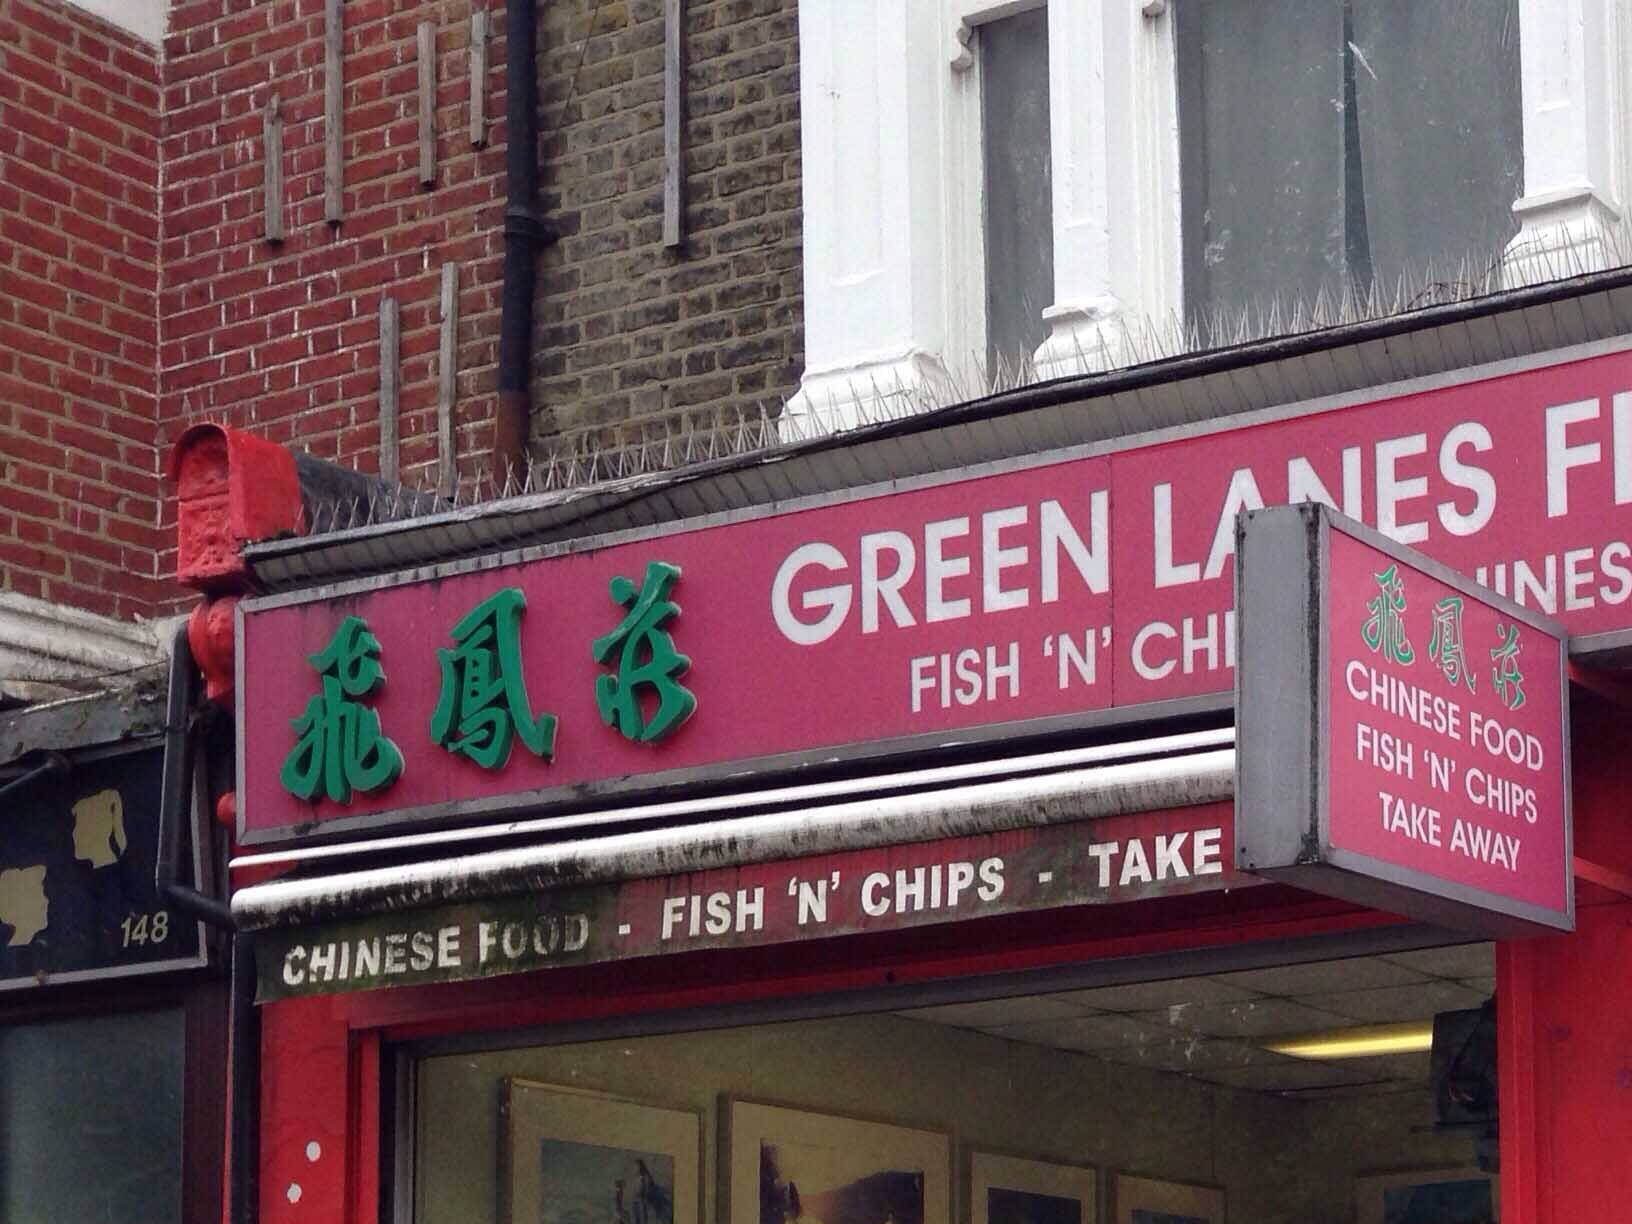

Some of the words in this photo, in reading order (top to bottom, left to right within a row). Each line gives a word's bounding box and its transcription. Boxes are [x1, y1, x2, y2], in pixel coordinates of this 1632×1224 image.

[771, 490, 1110, 646] GREEN
[1153, 420, 1497, 588] LANES
[911, 641, 1020, 713] FISH
[1131, 612, 1235, 681] CHI
[1345, 660, 1461, 741] CHINESE
[1469, 711, 1543, 771] FOOD
[1357, 722, 1414, 780] FISH
[1465, 767, 1538, 825] CHIPS
[1379, 791, 1441, 848] TAKE
[1450, 819, 1521, 873] AWAY
[120, 910, 169, 948] 148
[283, 924, 462, 986] CHINESE
[479, 912, 590, 963] FOOD
[661, 887, 764, 939] FISH
[861, 856, 1005, 917] CHIPS
[1089, 828, 1223, 888] TAKE
